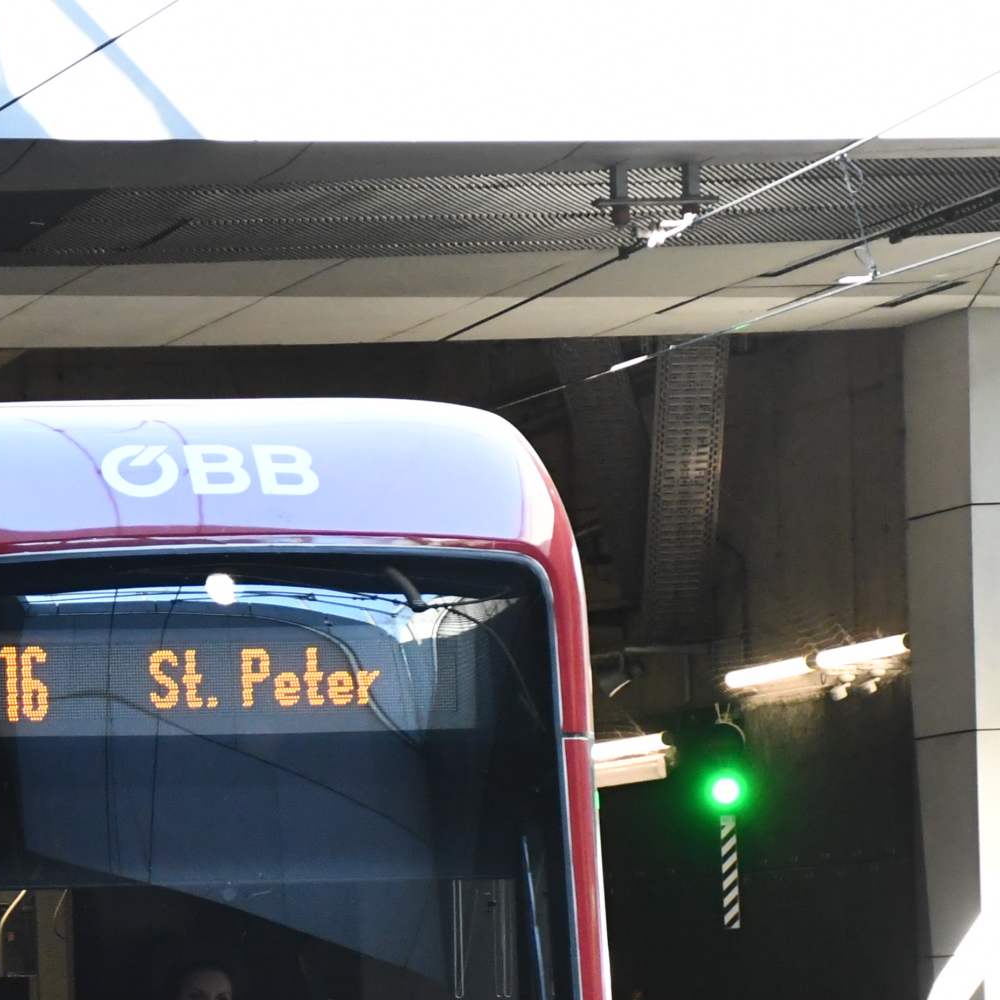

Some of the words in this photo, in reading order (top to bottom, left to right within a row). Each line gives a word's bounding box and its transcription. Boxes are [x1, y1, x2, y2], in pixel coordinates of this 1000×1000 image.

[101, 444, 320, 497] ÖBB
[149, 649, 218, 709] St.
[241, 647, 380, 707] Peter
